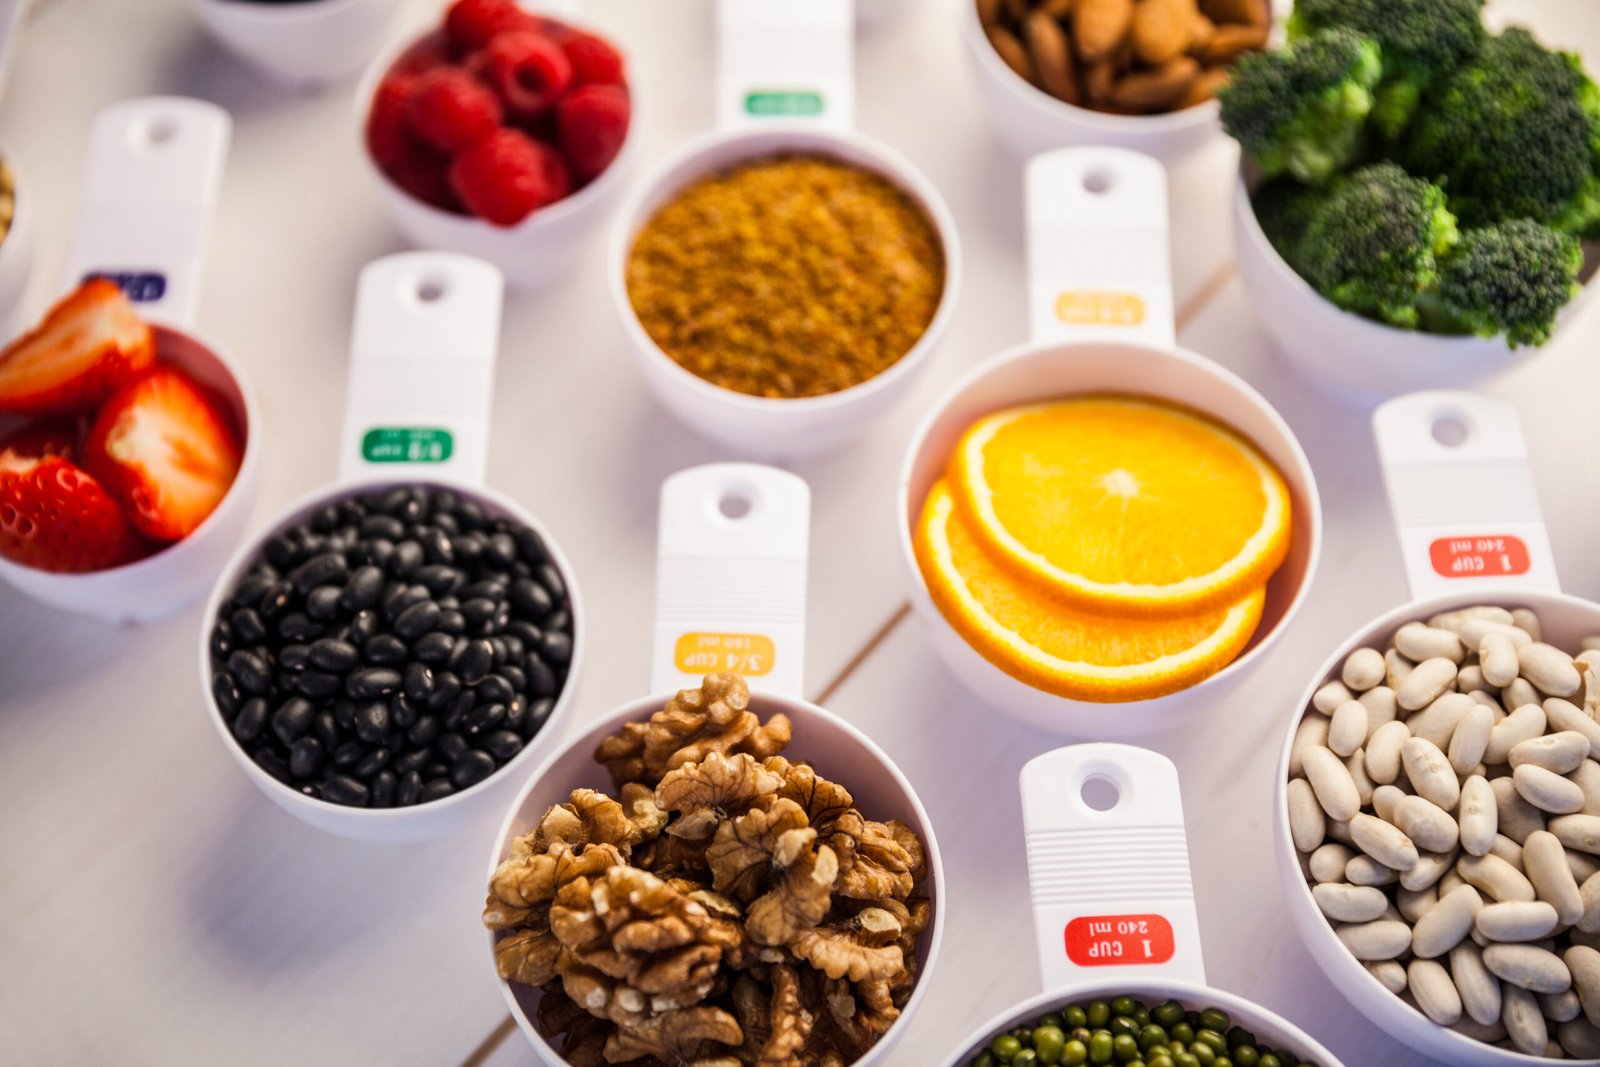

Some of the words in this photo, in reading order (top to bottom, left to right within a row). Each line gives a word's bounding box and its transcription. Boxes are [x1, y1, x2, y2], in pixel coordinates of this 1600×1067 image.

[1450, 540, 1472, 555] ml
[1476, 539, 1506, 553] 240
[1452, 555, 1485, 572] CUP
[1501, 554, 1512, 572] 1
[684, 652, 718, 667] CUP
[726, 652, 763, 671] 3/4
[1088, 922, 1113, 937] ml
[1117, 921, 1149, 935] 240
[1088, 940, 1124, 958] CUP
[1141, 939, 1154, 958] 1
